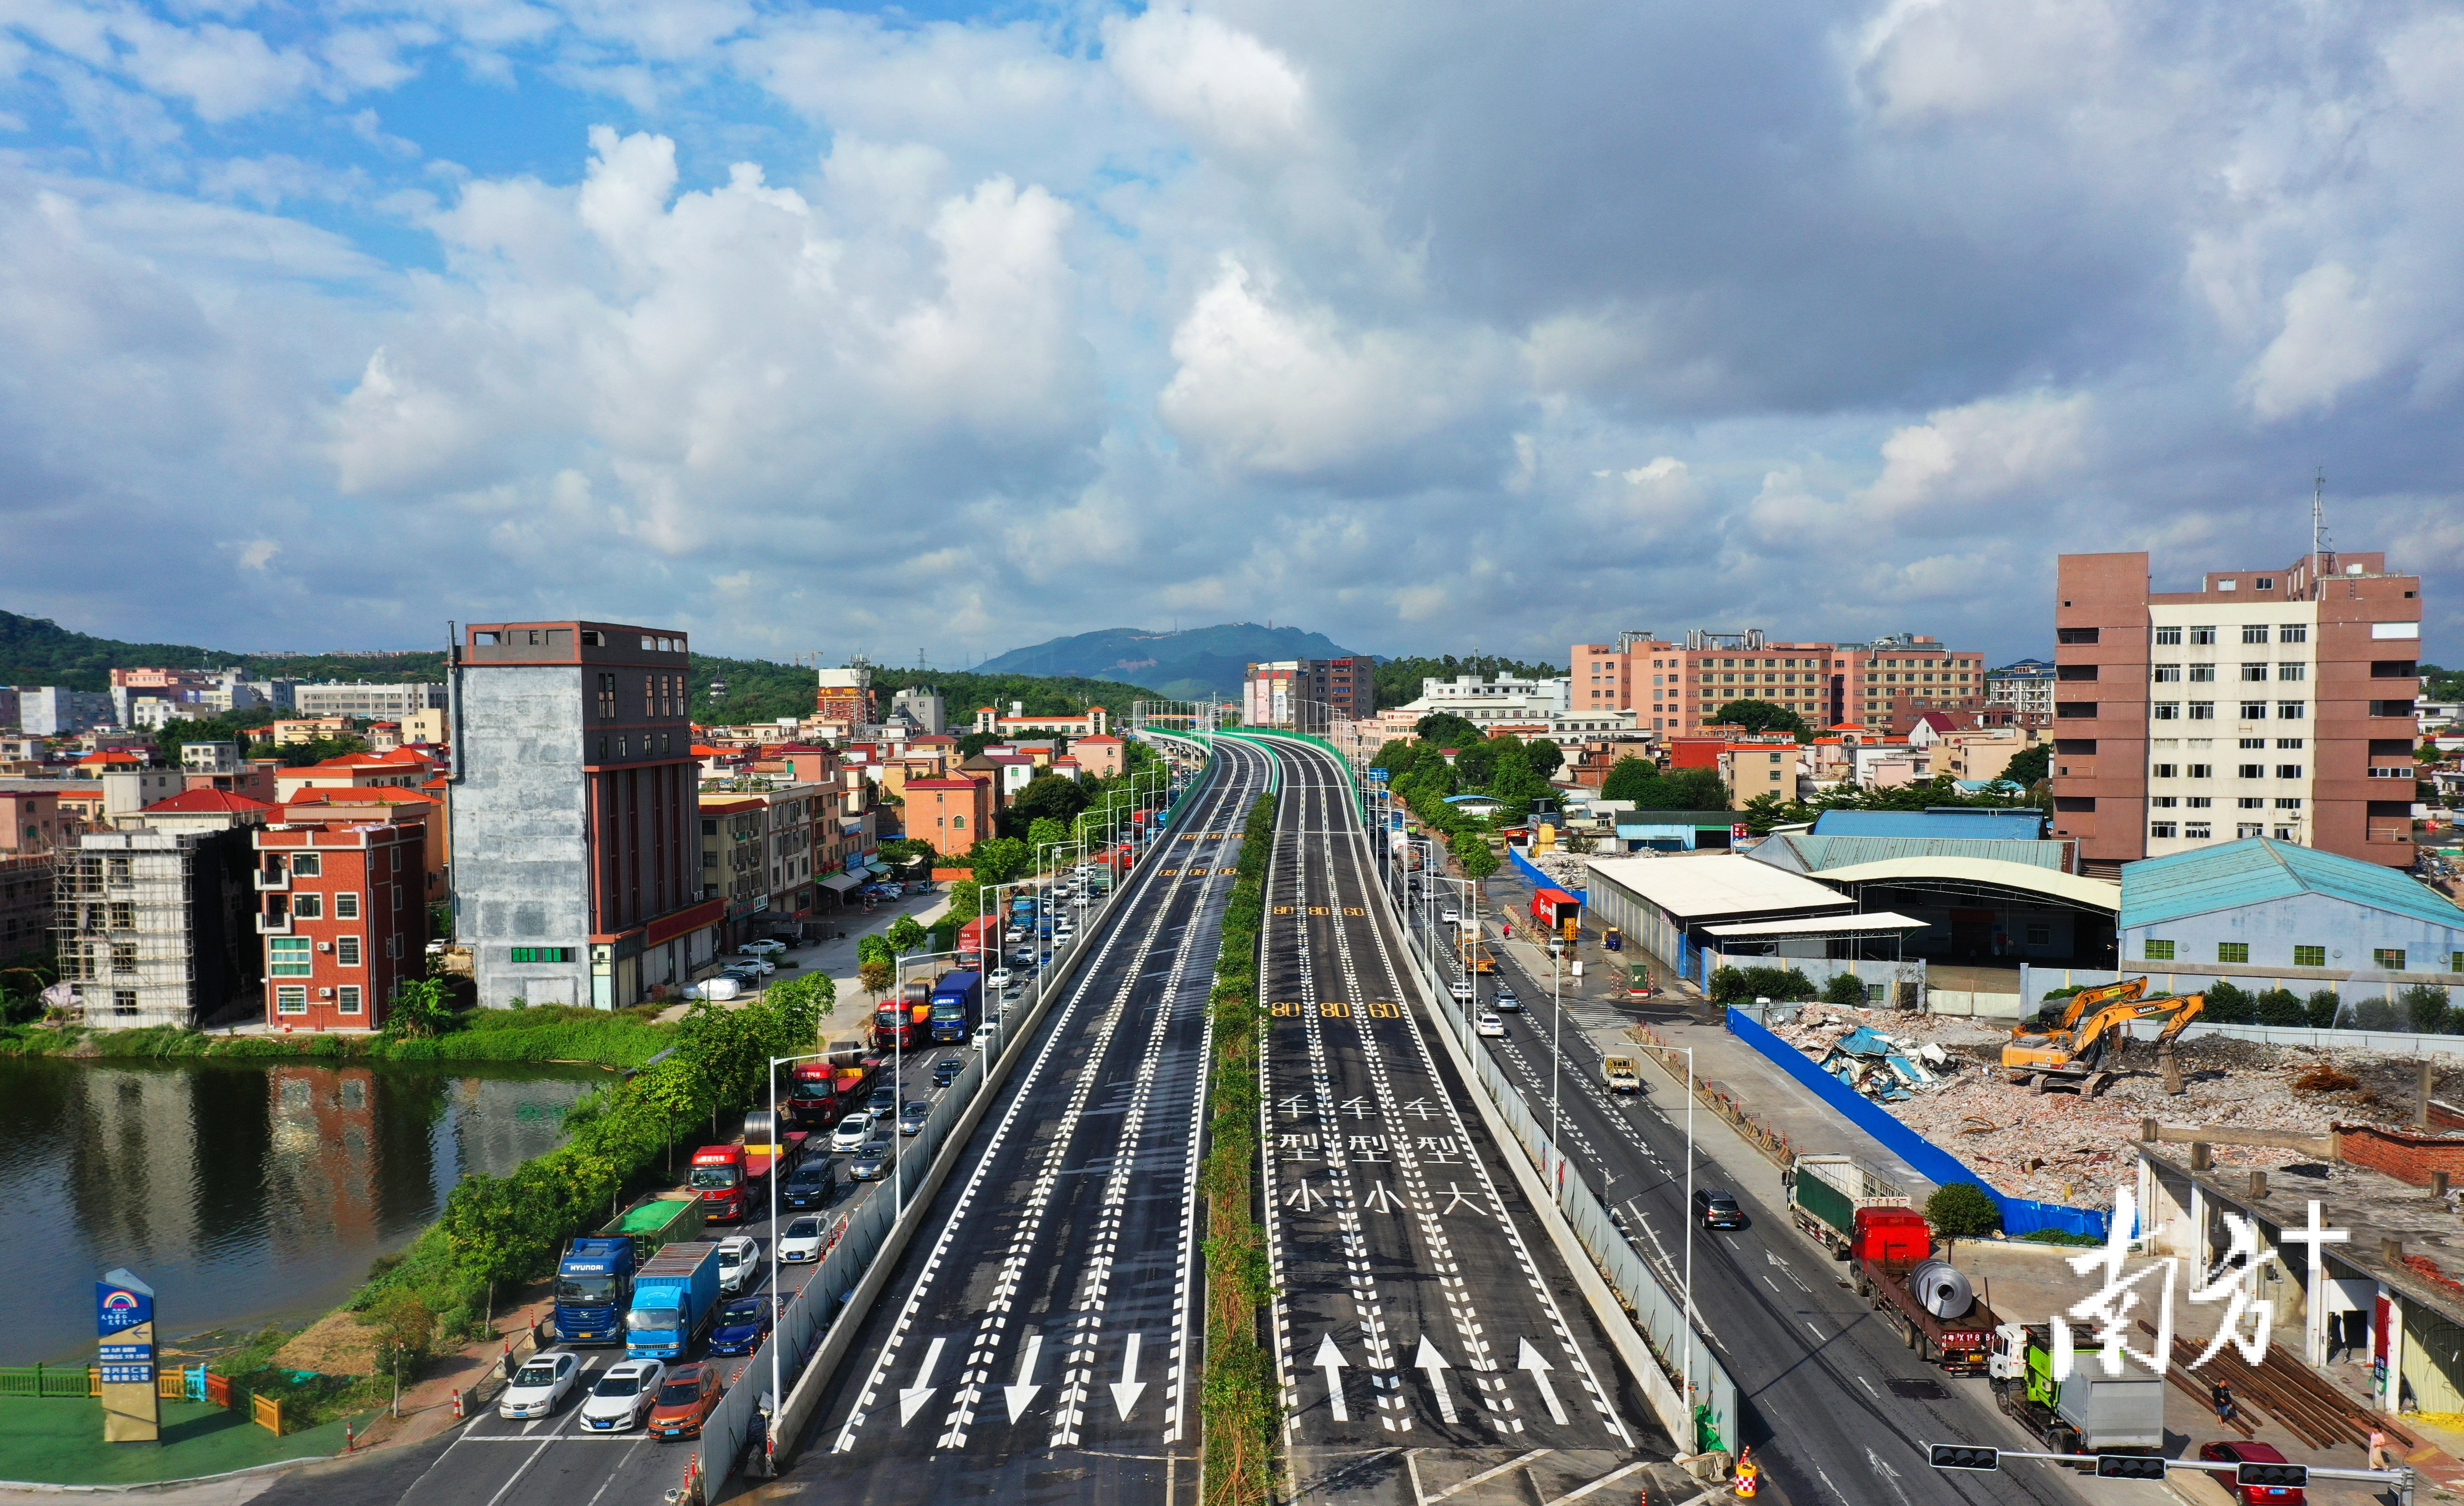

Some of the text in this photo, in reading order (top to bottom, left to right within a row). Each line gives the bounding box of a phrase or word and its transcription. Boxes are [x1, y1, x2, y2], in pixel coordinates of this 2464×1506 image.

[1273, 906, 1365, 916] 80 80 60
[1271, 1002, 1400, 1018] 80 80 60
